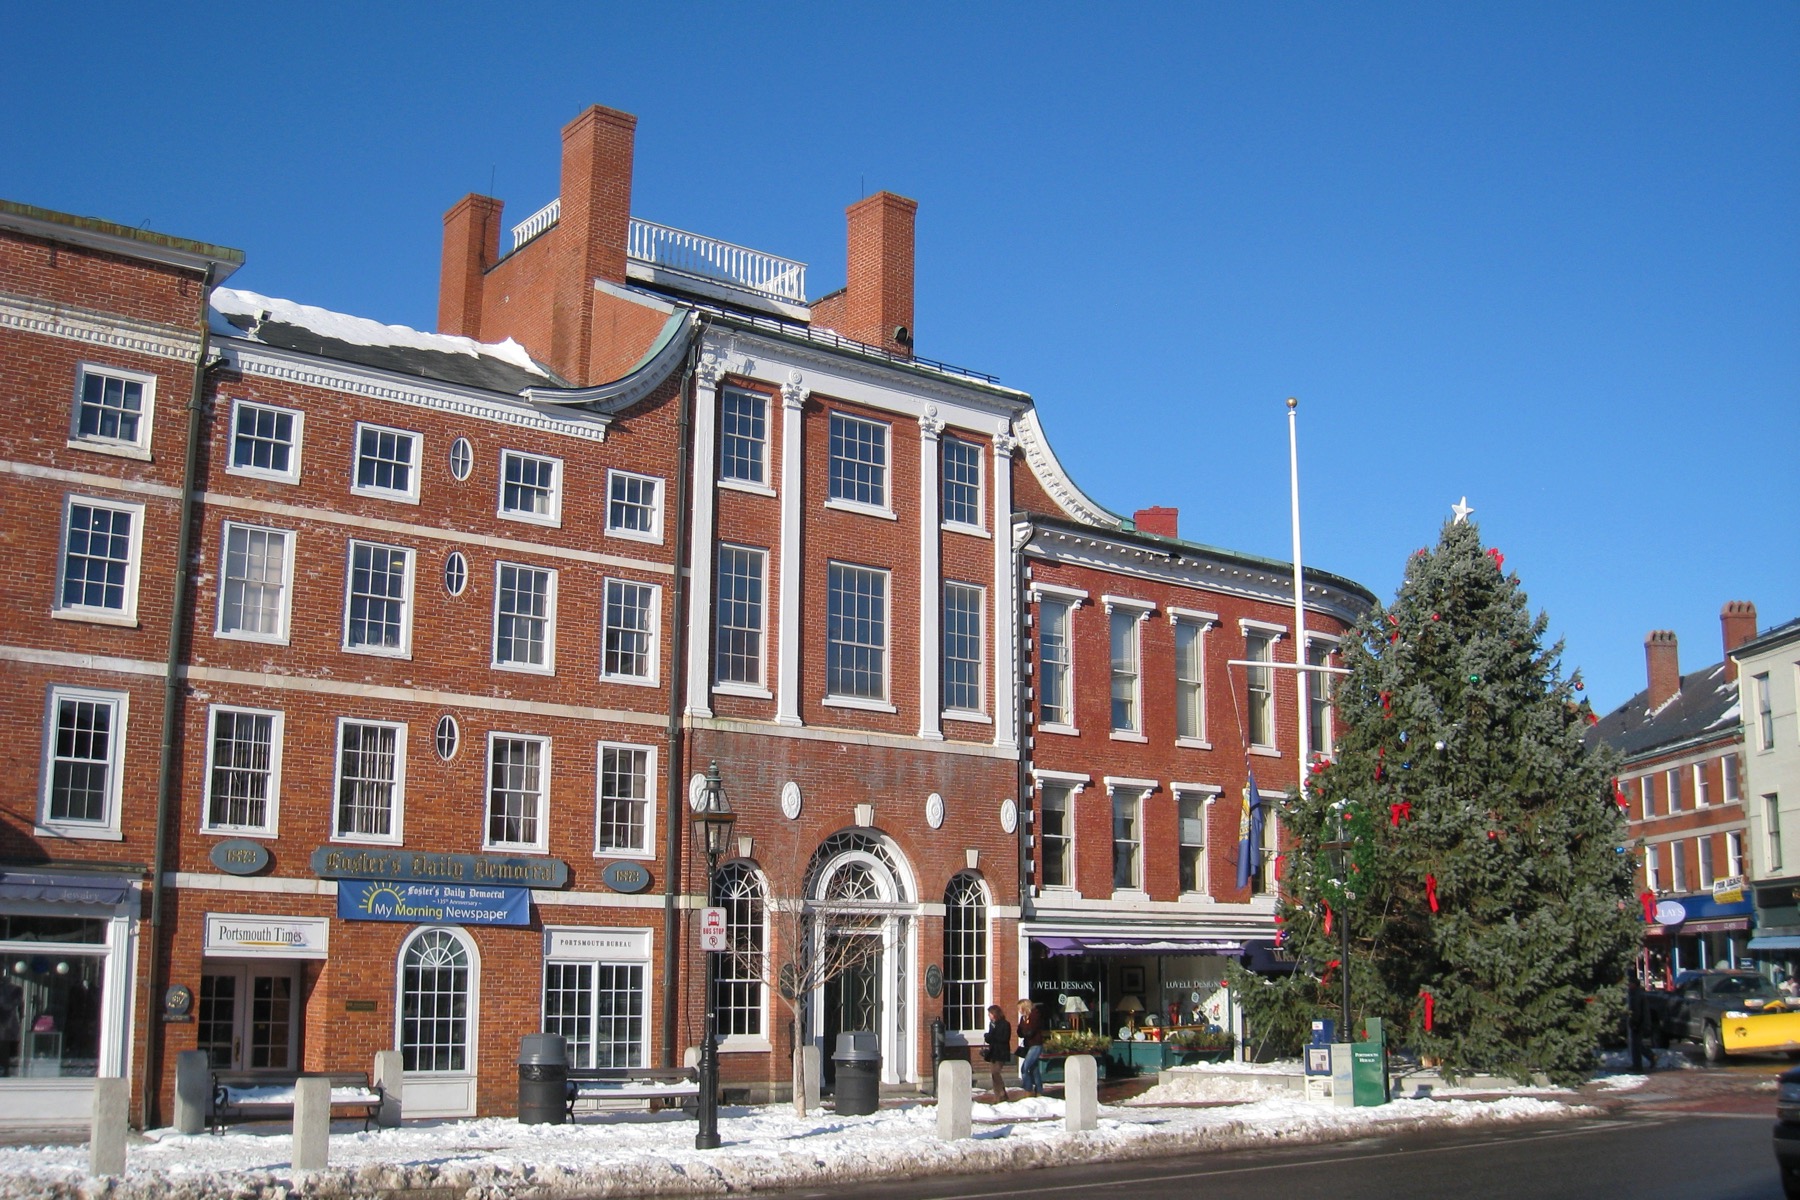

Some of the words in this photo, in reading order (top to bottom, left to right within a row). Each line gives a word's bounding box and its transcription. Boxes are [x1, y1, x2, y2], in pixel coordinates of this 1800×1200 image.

[325, 851, 401, 875] Foster's
[411, 854, 463, 880] Daily
[474, 857, 556, 881] Democrat
[408, 885, 440, 897] Foster's
[444, 887, 465, 898] Daily
[469, 888, 505, 899] Democrat
[449, 899, 478, 907] Anniversary
[374, 903, 393, 918] My
[395, 904, 443, 920] Morning
[446, 906, 508, 921] Newspaper
[219, 925, 272, 942] Portsmouth
[274, 927, 302, 944] Times
[560, 939, 605, 947] PORTSMOUTH
[1031, 981, 1059, 990] OVELL
[1061, 981, 1093, 990] DESIGNS
[1165, 980, 1191, 989] LOVELL
